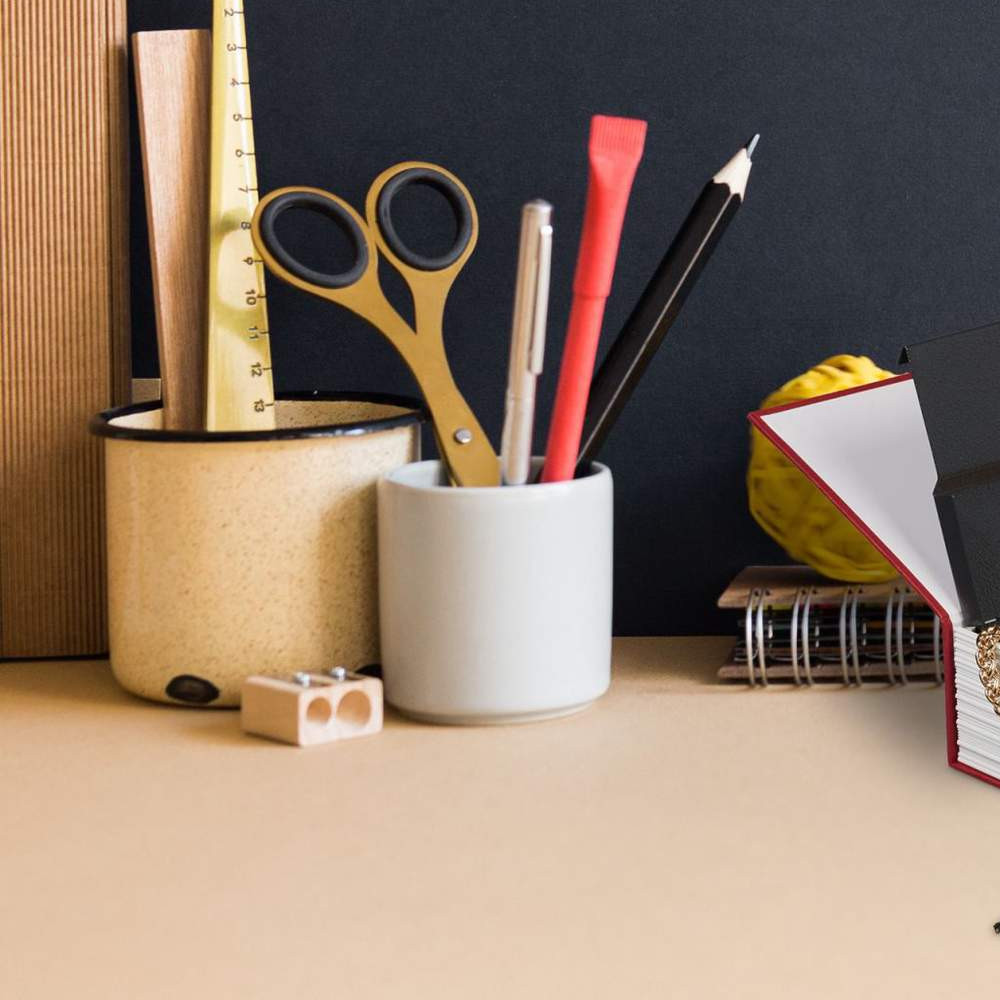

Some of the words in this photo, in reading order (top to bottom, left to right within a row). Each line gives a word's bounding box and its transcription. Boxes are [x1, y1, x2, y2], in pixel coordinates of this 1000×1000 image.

[224, 8, 234, 17] 2
[226, 43, 237, 52] 3
[230, 78, 240, 87] 4
[233, 113, 242, 122] 5
[235, 149, 245, 158] 6
[238, 184, 248, 194] 7
[240, 221, 251, 230] 8
[243, 256, 254, 266] 9
[245, 289, 257, 306] 10
[248, 326, 259, 340] 11
[251, 362, 263, 378] 12
[254, 399, 265, 413] 13
